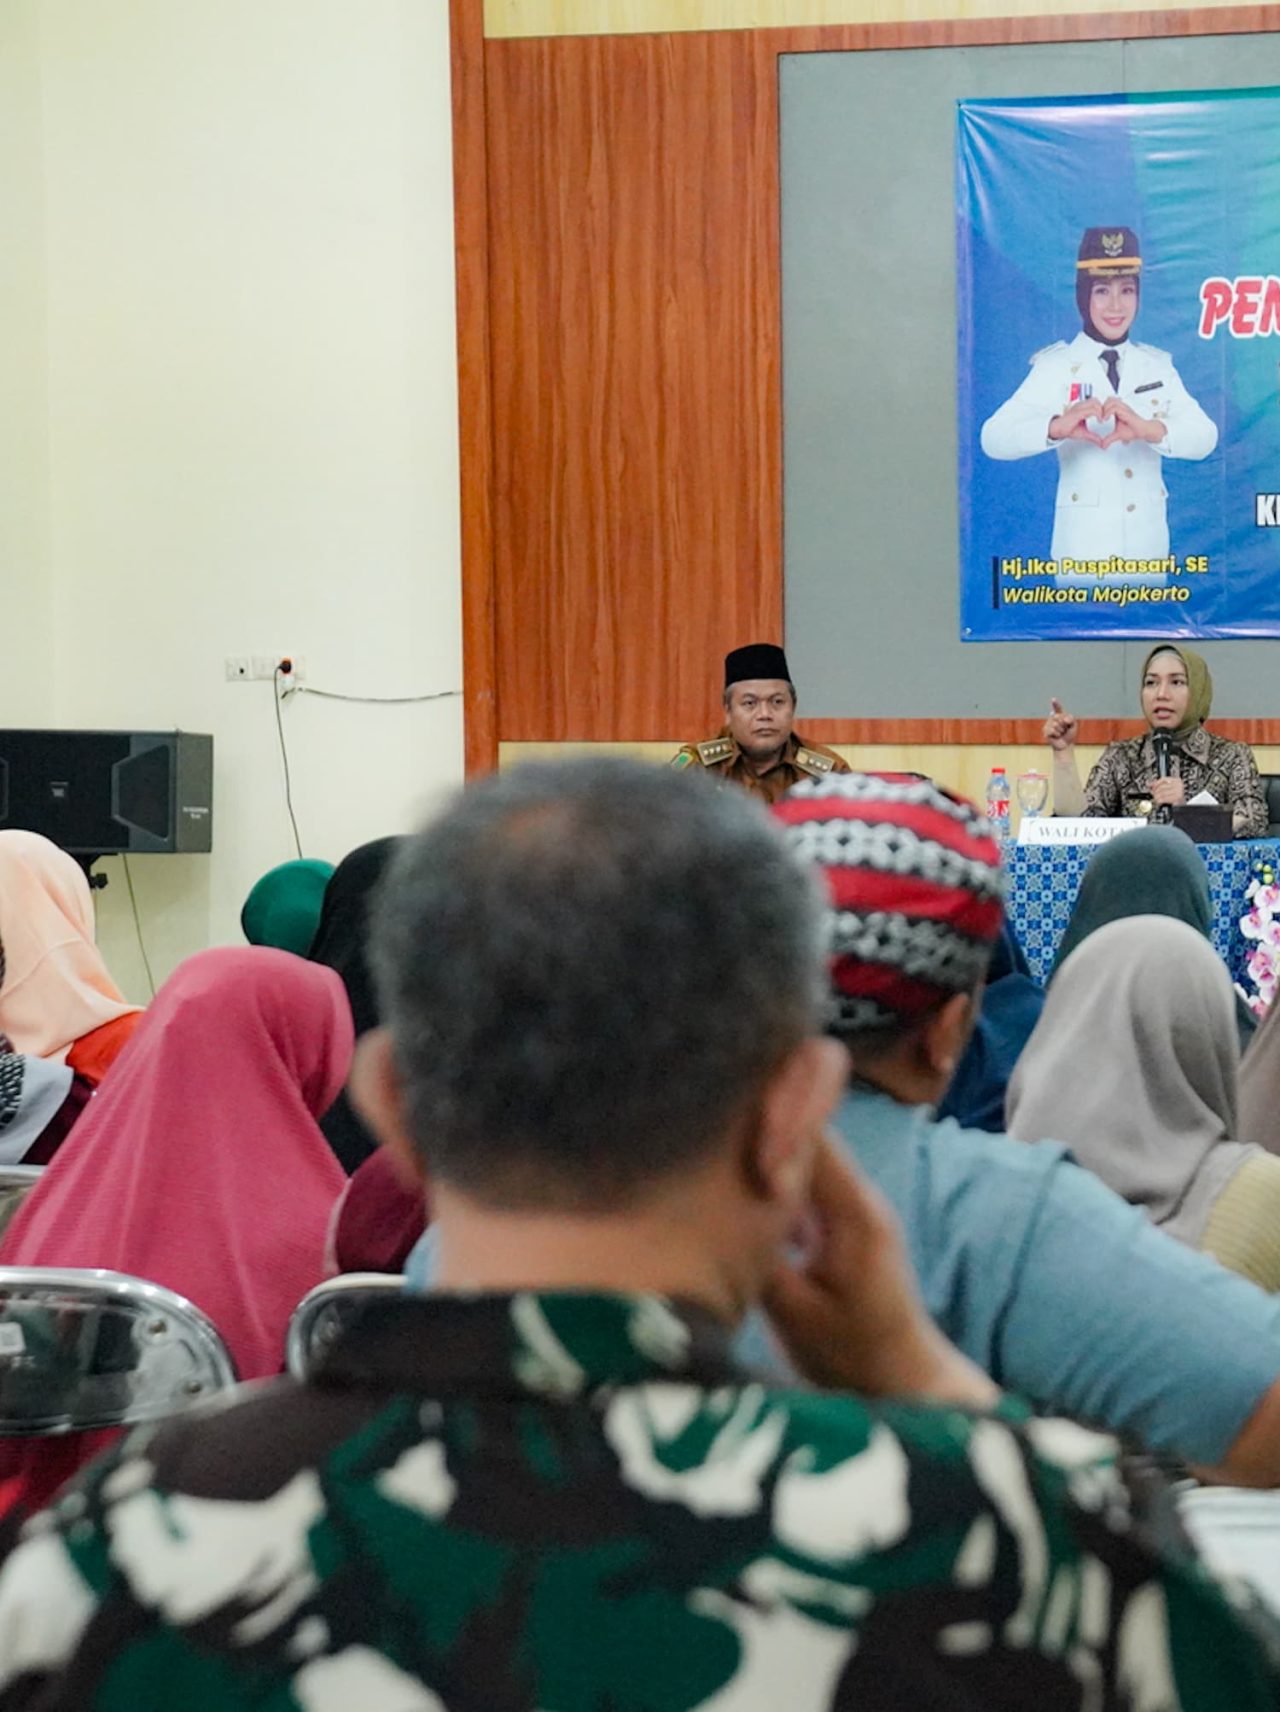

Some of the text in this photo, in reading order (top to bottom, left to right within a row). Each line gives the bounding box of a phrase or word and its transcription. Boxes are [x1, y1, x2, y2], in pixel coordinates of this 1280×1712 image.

[1001, 555, 1209, 580] Hj.Ika Puspitasari, SE
[1003, 585, 1190, 607] Walikota Mojokerto
